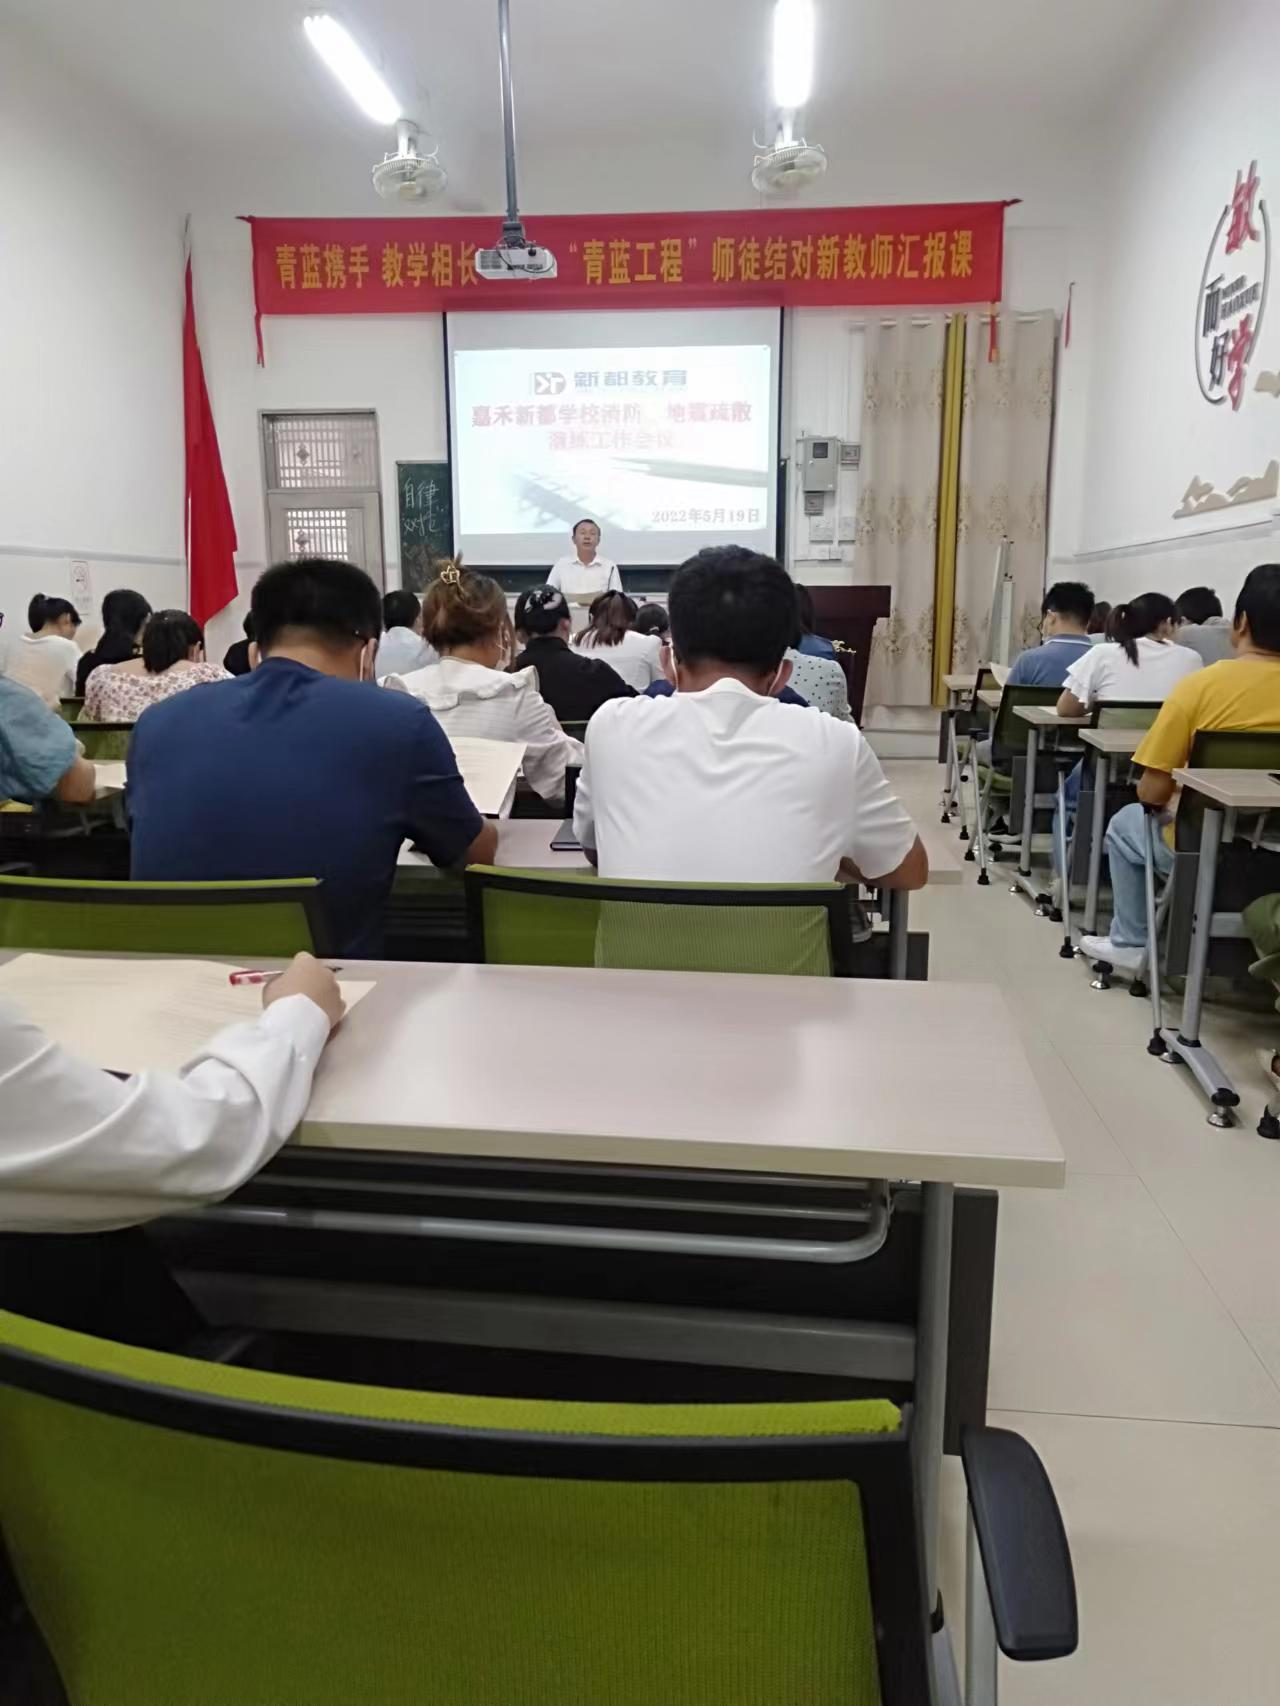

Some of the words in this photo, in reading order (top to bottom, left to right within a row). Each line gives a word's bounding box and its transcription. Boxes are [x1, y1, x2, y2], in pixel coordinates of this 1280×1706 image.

[276, 243, 369, 289] 青蓝携手
[382, 241, 478, 288] 教学相长
[712, 229, 974, 283] 师徒结对新教师汇报课
[574, 369, 688, 388] 新都教育
[651, 508, 761, 524] 2022年5月19日
